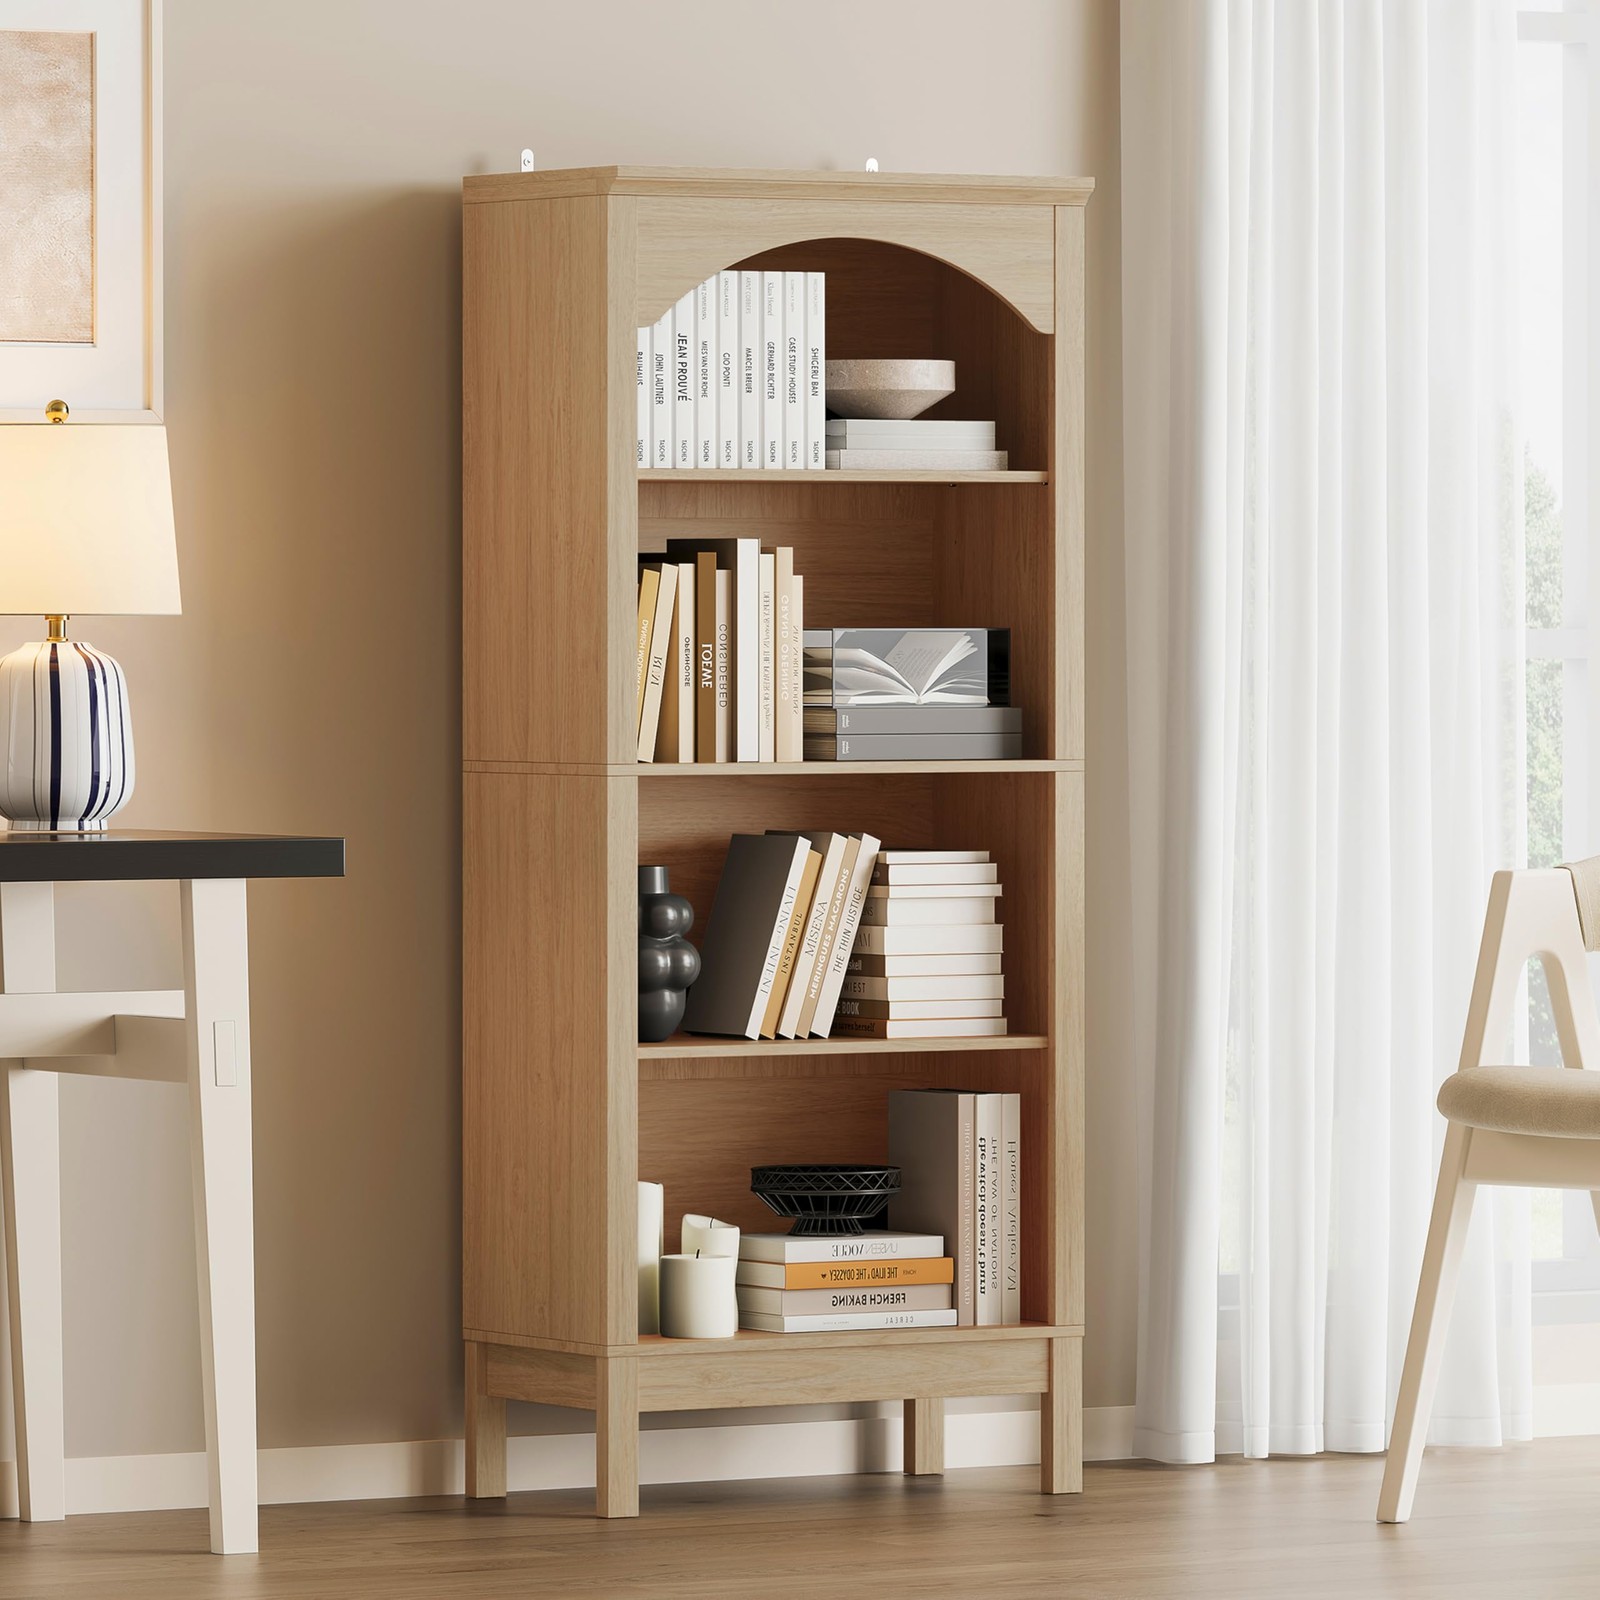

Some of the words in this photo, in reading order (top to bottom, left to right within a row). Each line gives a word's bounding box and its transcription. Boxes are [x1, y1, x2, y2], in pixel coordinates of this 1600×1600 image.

[677, 333, 688, 359] JEAN
[767, 341, 775, 371] GERHARD
[788, 337, 796, 353] CASE
[655, 353, 664, 372] JOHN
[722, 352, 731, 366] GIO
[745, 347, 753, 372] MARCEL
[788, 354, 796, 376] STUDY
[811, 347, 819, 379] SHIGERU
[655, 373, 664, 405] LAUTNER
[677, 361, 692, 401] PROUVÉ
[722, 366, 731, 388] PONTI
[745, 373, 753, 394] BREUER
[767, 372, 775, 400] RICHTER
[811, 381, 819, 397] BAN
[788, 377, 796, 404] HOUSES
[846, 886, 864, 929] JUSTICE
[781, 912, 803, 974] INSTANBUL
[809, 934, 832, 999] MERINGUES
[828, 868, 850, 933] MACARONS
[839, 929, 852, 952] THIN
[833, 955, 846, 974] THE
[842, 1001, 860, 1015] BOOK
